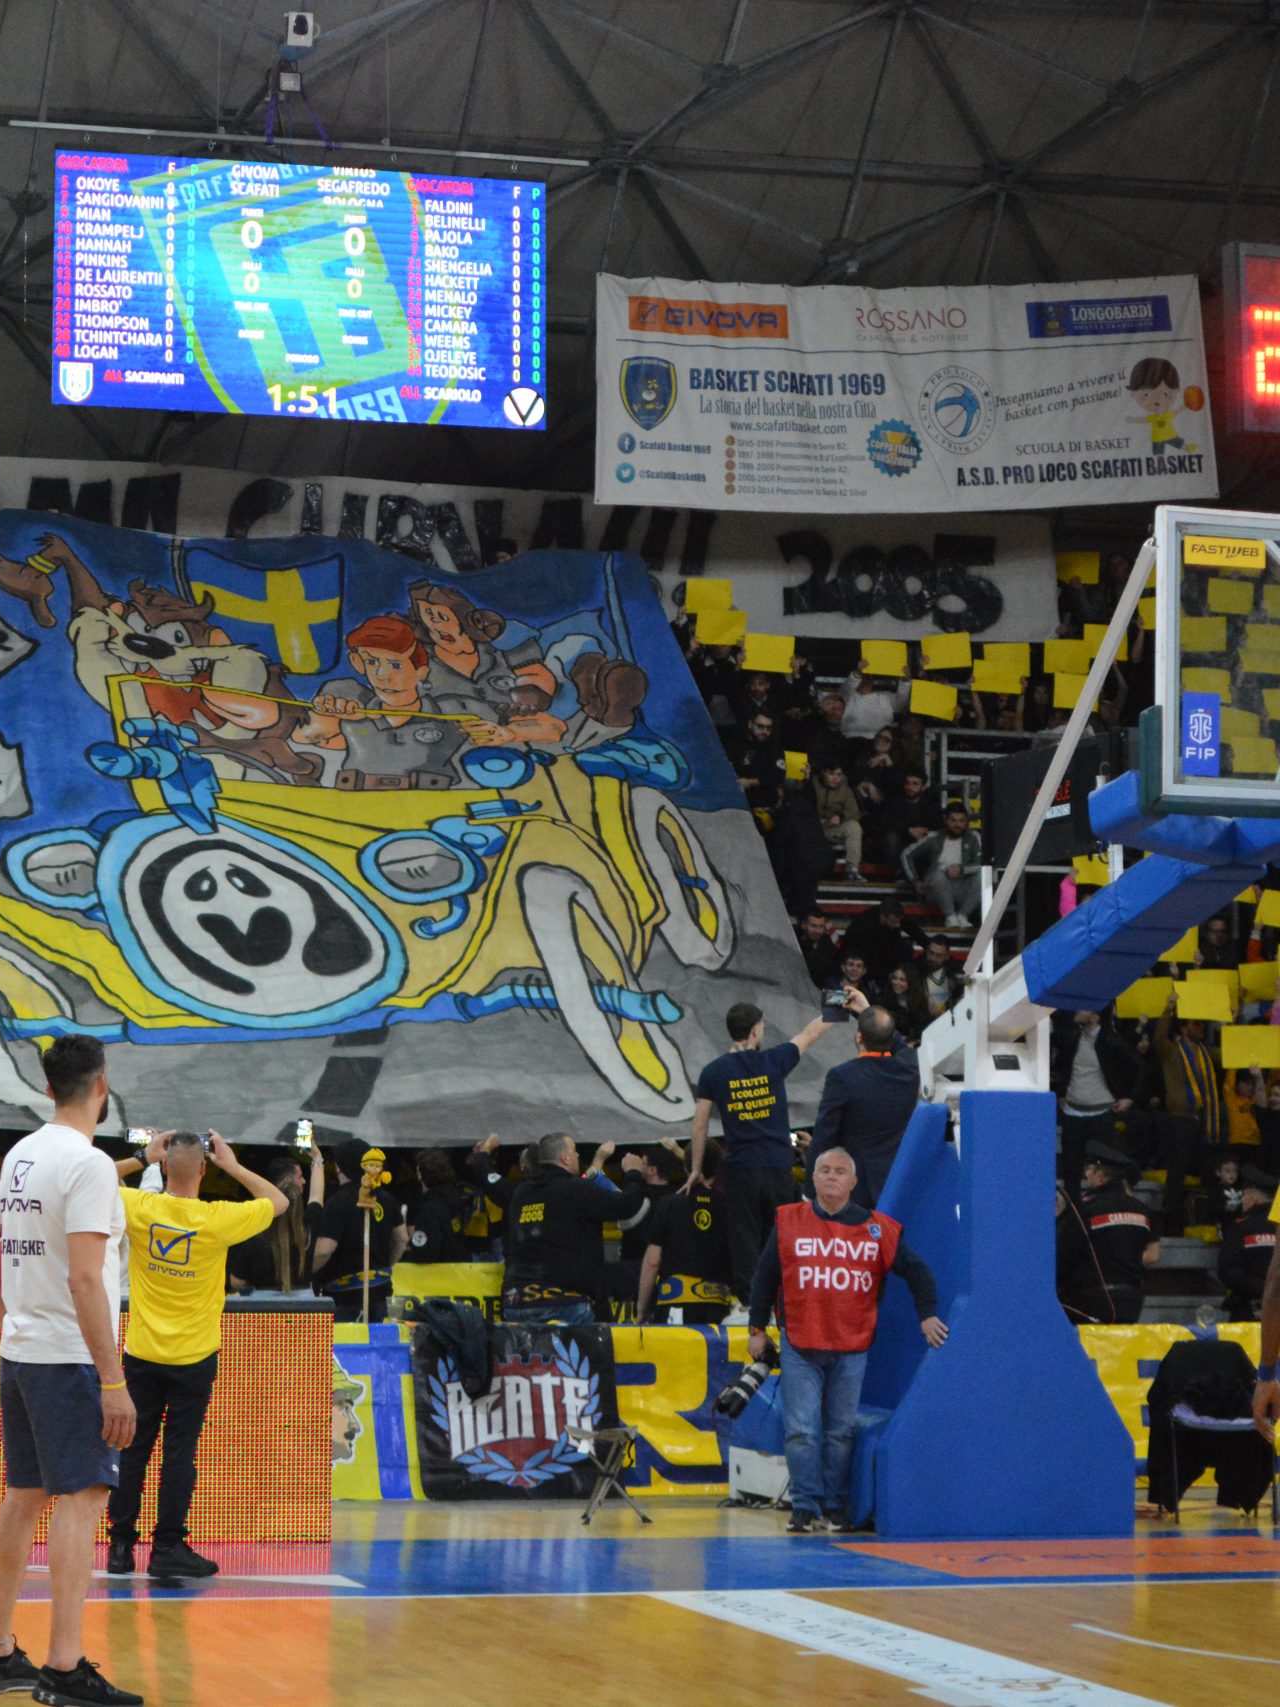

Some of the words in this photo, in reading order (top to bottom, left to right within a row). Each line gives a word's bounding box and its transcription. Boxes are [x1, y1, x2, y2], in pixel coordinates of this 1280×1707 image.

[57, 155, 128, 173] GIOCATORI
[232, 164, 280, 180] GIVOVA
[76, 176, 120, 192] OKOYE
[230, 181, 280, 197] SCAFATI
[317, 178, 391, 196] SEGAFREDO
[407, 178, 473, 196] GIOCATORI
[76, 191, 164, 209] SANGIOVANNI
[425, 199, 473, 215] FALDINI
[76, 206, 111, 221] MIAN
[76, 222, 144, 239] KRAMPELJ
[425, 214, 486, 231] BELINELLI
[241, 220, 263, 249] 0
[344, 227, 365, 256] 0
[425, 229, 473, 245] PAJOLA
[76, 237, 131, 253] HANNAH
[425, 244, 459, 259] BAKO
[75, 252, 128, 269] PINKINS
[424, 258, 493, 277] SHENGELIA
[75, 267, 93, 282] DE
[96, 269, 162, 286] LAURENTII
[244, 272, 260, 293] 0
[425, 273, 480, 291] HACKETT
[75, 283, 132, 300] ROSSATO
[347, 278, 363, 298] 0
[424, 288, 478, 305] MENALO
[74, 298, 123, 314] IMBRO'
[424, 303, 472, 320] MICKEY
[1071, 303, 1154, 322] LONGOBARDI
[74, 313, 149, 331] THOMPSON
[424, 318, 478, 335] CAMARA
[664, 307, 779, 329] GIVOVA
[856, 304, 968, 332] ROSSANO
[74, 328, 162, 346] TCHINTCHARA
[424, 334, 471, 350] WEEMS
[74, 344, 118, 360] LOGAN
[424, 348, 477, 365] OJELEYE
[424, 364, 487, 381] TEODOSIC
[689, 367, 760, 393] BASKET
[763, 370, 834, 397] SCAFATI
[837, 373, 887, 396] 1969
[267, 384, 337, 415] 1:51
[400, 385, 421, 399] ALL
[993, 385, 1065, 408] Insegniamo
[1077, 374, 1115, 390] vivere
[715, 397, 742, 416] storia
[744, 397, 761, 416] del
[763, 398, 795, 418] basket
[819, 400, 853, 420] nostra
[1005, 404, 1044, 423] basket
[1047, 399, 1069, 413] con
[729, 420, 848, 436] www.scafatibasket.com
[1016, 442, 1067, 456] SCUOLA
[1069, 440, 1082, 452] DI
[1084, 437, 1132, 452] BASKET
[957, 466, 999, 487] A.S.D.
[1002, 464, 1035, 485] PRO
[1039, 461, 1078, 483] LOCO
[1081, 457, 1143, 480] SCAFATI
[1146, 453, 1204, 476] BASKET
[1191, 543, 1260, 559] FASTWEB
[776, 529, 1005, 635] 2005
[1185, 746, 1217, 760] FIP
[729, 1080, 740, 1089] DI
[741, 1075, 768, 1088] TUTTI
[737, 1086, 770, 1099] COLORI
[727, 1102, 744, 1112] PER
[744, 1096, 777, 1110] QUESTI
[738, 1109, 770, 1121] COLORI
[794, 1236, 881, 1262] GIVOVA
[147, 1262, 196, 1279] GIVOVA
[798, 1265, 874, 1294] PHOTO
